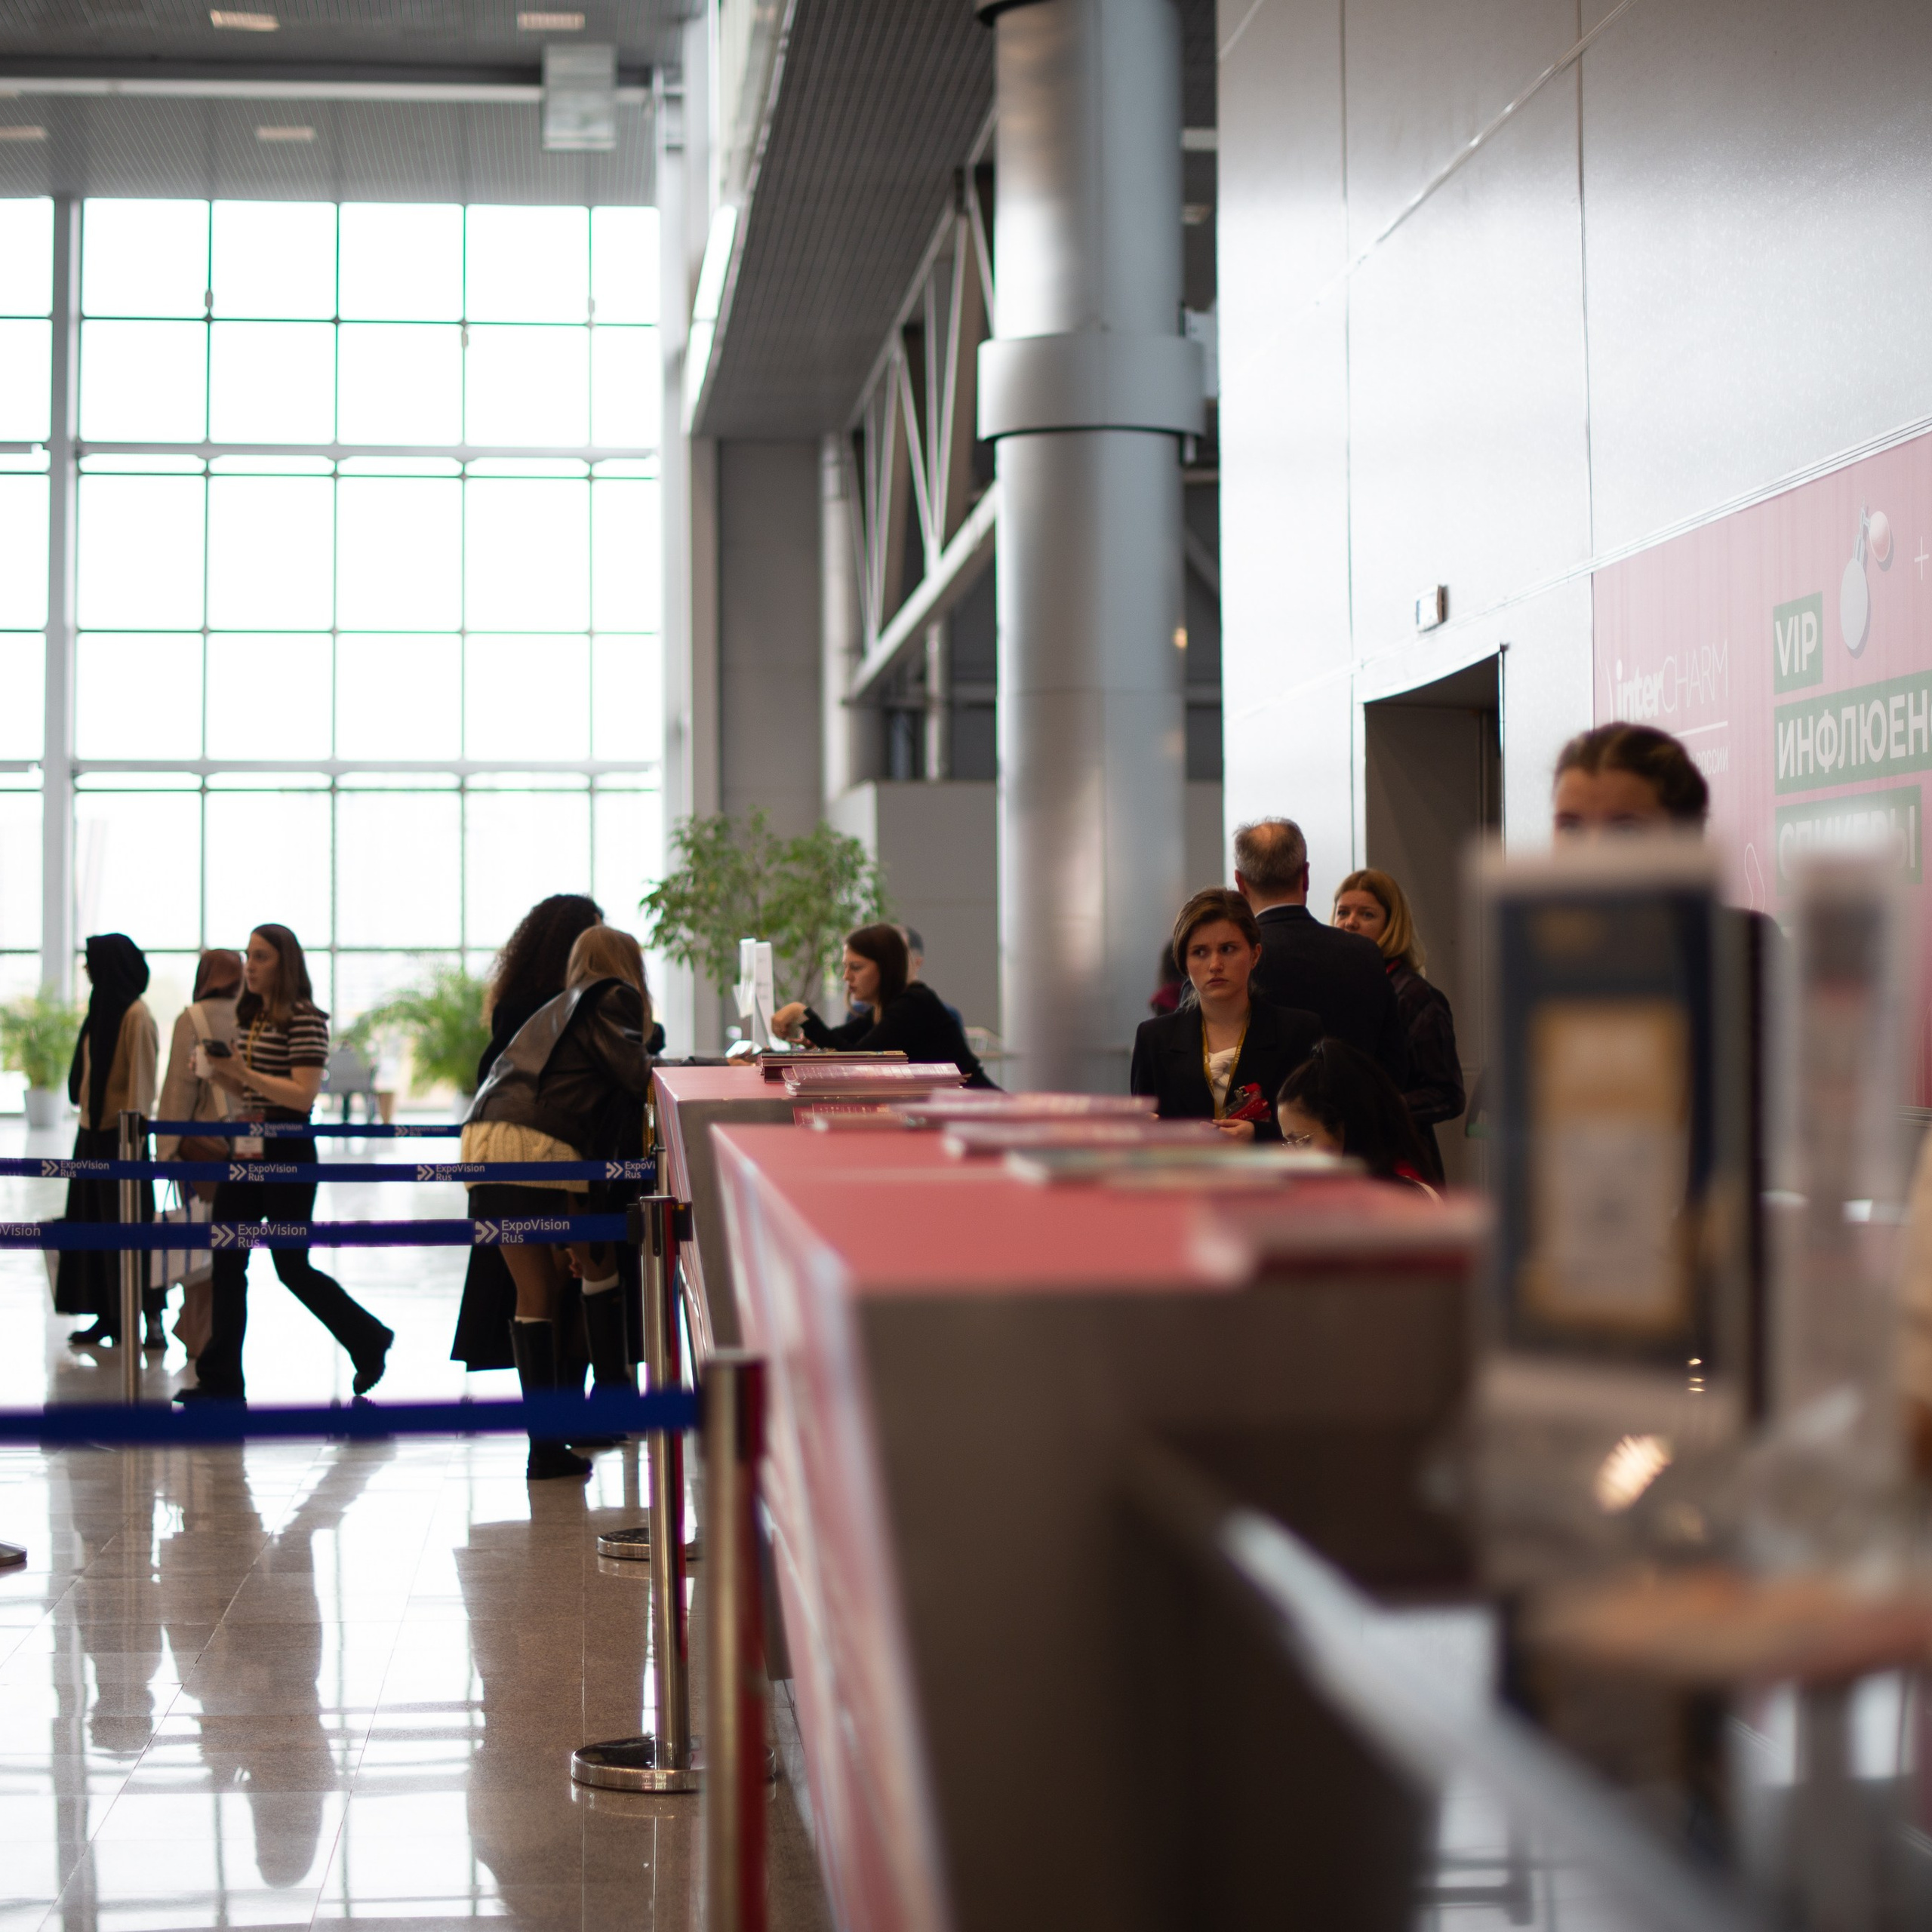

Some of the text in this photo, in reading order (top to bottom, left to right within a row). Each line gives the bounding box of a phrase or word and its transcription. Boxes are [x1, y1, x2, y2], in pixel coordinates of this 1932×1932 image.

[1775, 611, 1817, 677] VIP
[1616, 638, 1728, 723] interCHARM
[1778, 689, 1932, 780] ИНФЛЮЕН
[60, 1160, 109, 1170] ExpoVision
[248, 1164, 297, 1174] ExpoVision
[435, 1164, 485, 1174] ExpoVision
[60, 1169, 77, 1177] Rus
[248, 1173, 265, 1182] Rus
[435, 1173, 453, 1181] Rus
[625, 1170, 641, 1179] Rus
[0, 1224, 41, 1236] Vision
[238, 1224, 307, 1238] ExpoVision
[501, 1219, 570, 1234] ExpoVision
[238, 1236, 260, 1247] Rus
[501, 1232, 524, 1244] Rus
